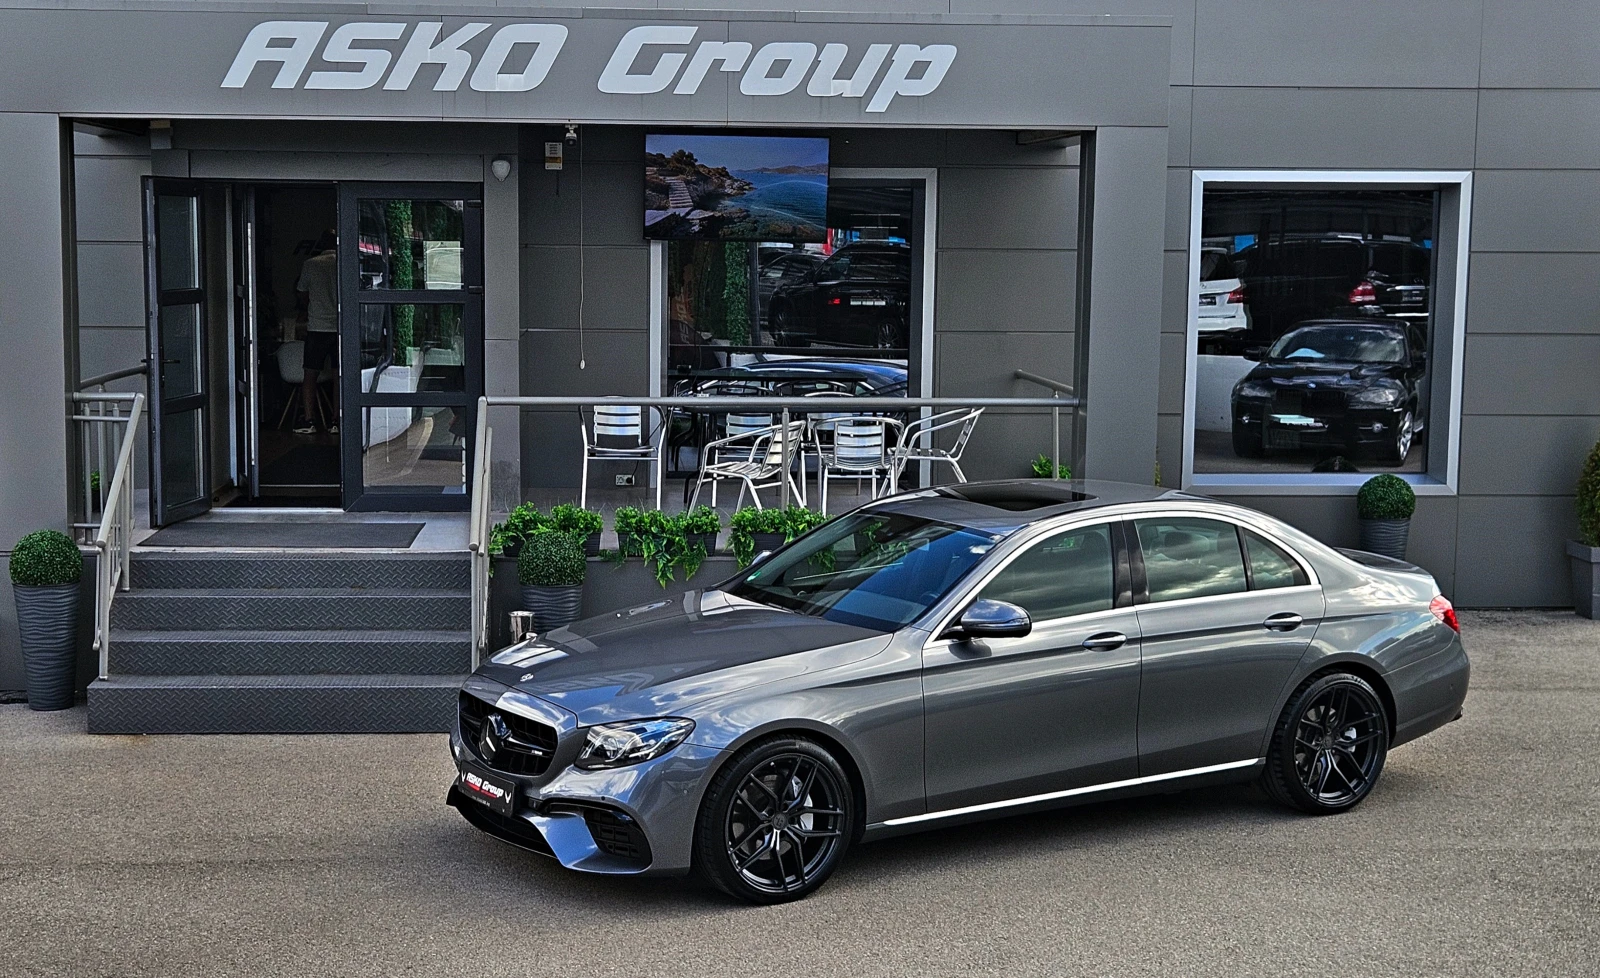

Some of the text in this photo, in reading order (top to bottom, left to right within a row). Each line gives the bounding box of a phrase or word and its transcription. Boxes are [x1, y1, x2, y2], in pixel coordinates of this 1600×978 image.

[220, 20, 957, 113] ASKO Group
[466, 772, 504, 798] ASKO Group
